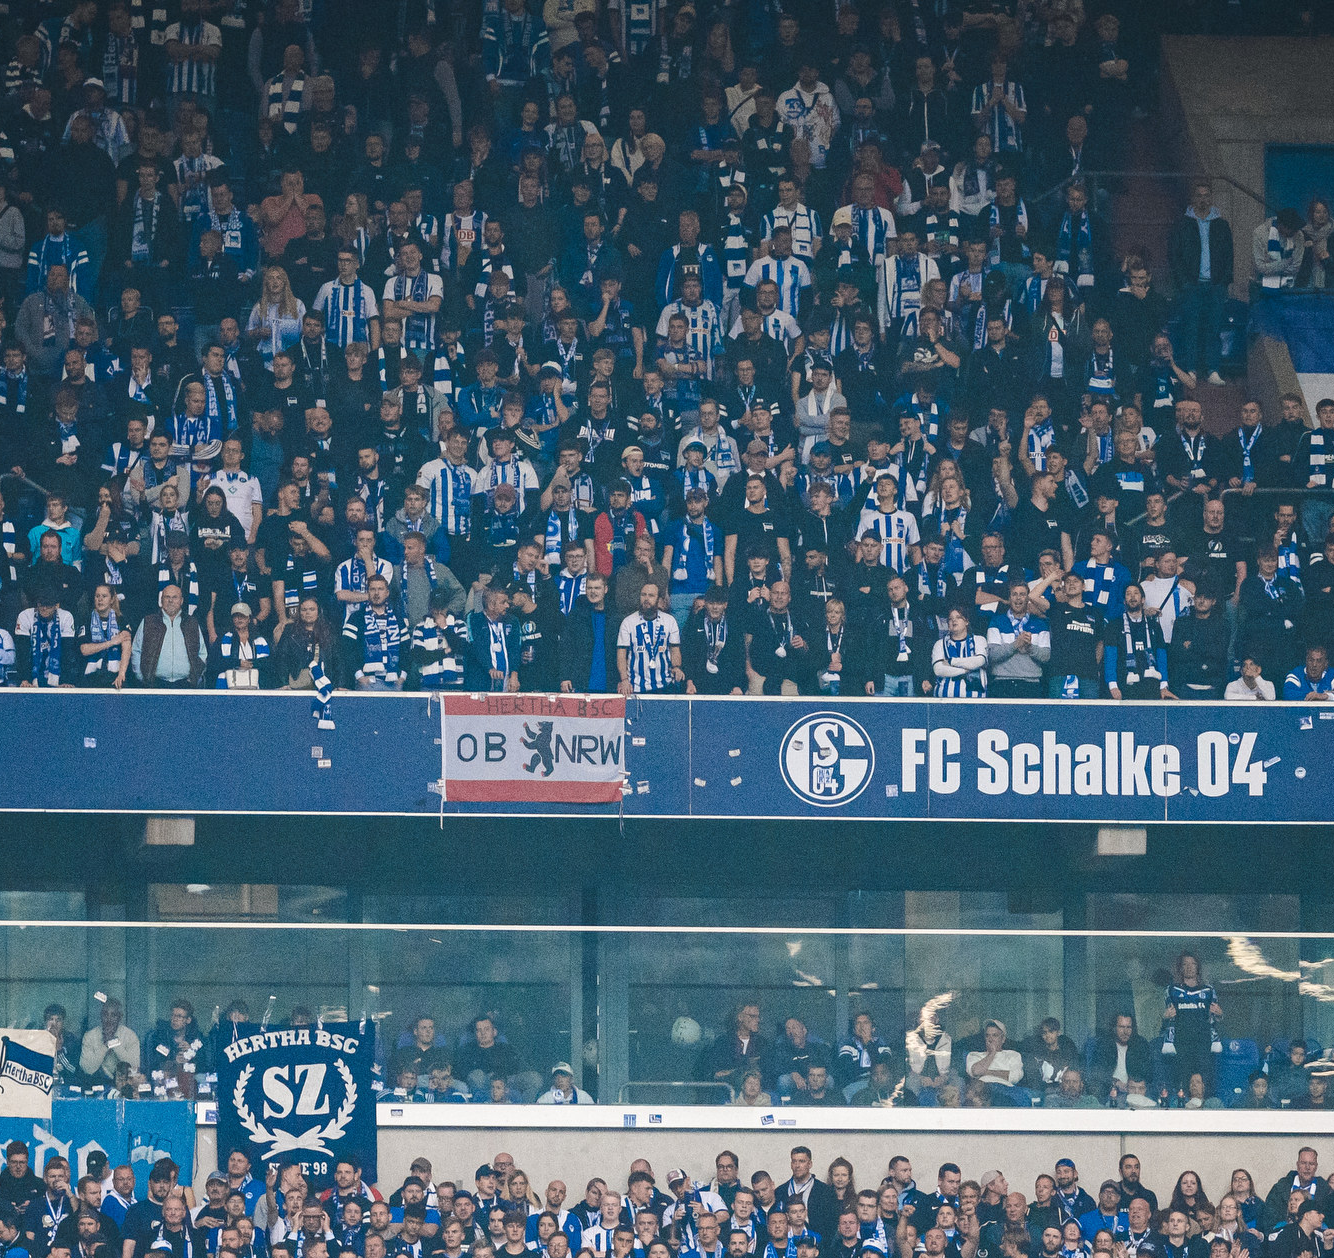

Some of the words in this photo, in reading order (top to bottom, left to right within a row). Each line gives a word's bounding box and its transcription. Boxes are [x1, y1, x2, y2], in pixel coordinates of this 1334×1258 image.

[486, 697, 566, 716] HERTHA
[576, 698, 614, 717] BSC
[554, 733, 622, 767] NRW
[902, 728, 961, 795] FC
[977, 729, 1181, 797] Schalke
[1197, 731, 1267, 797] 04
[223, 1029, 311, 1063] HERTHA
[315, 1028, 360, 1055] BSC
[262, 1064, 331, 1119] SZ
